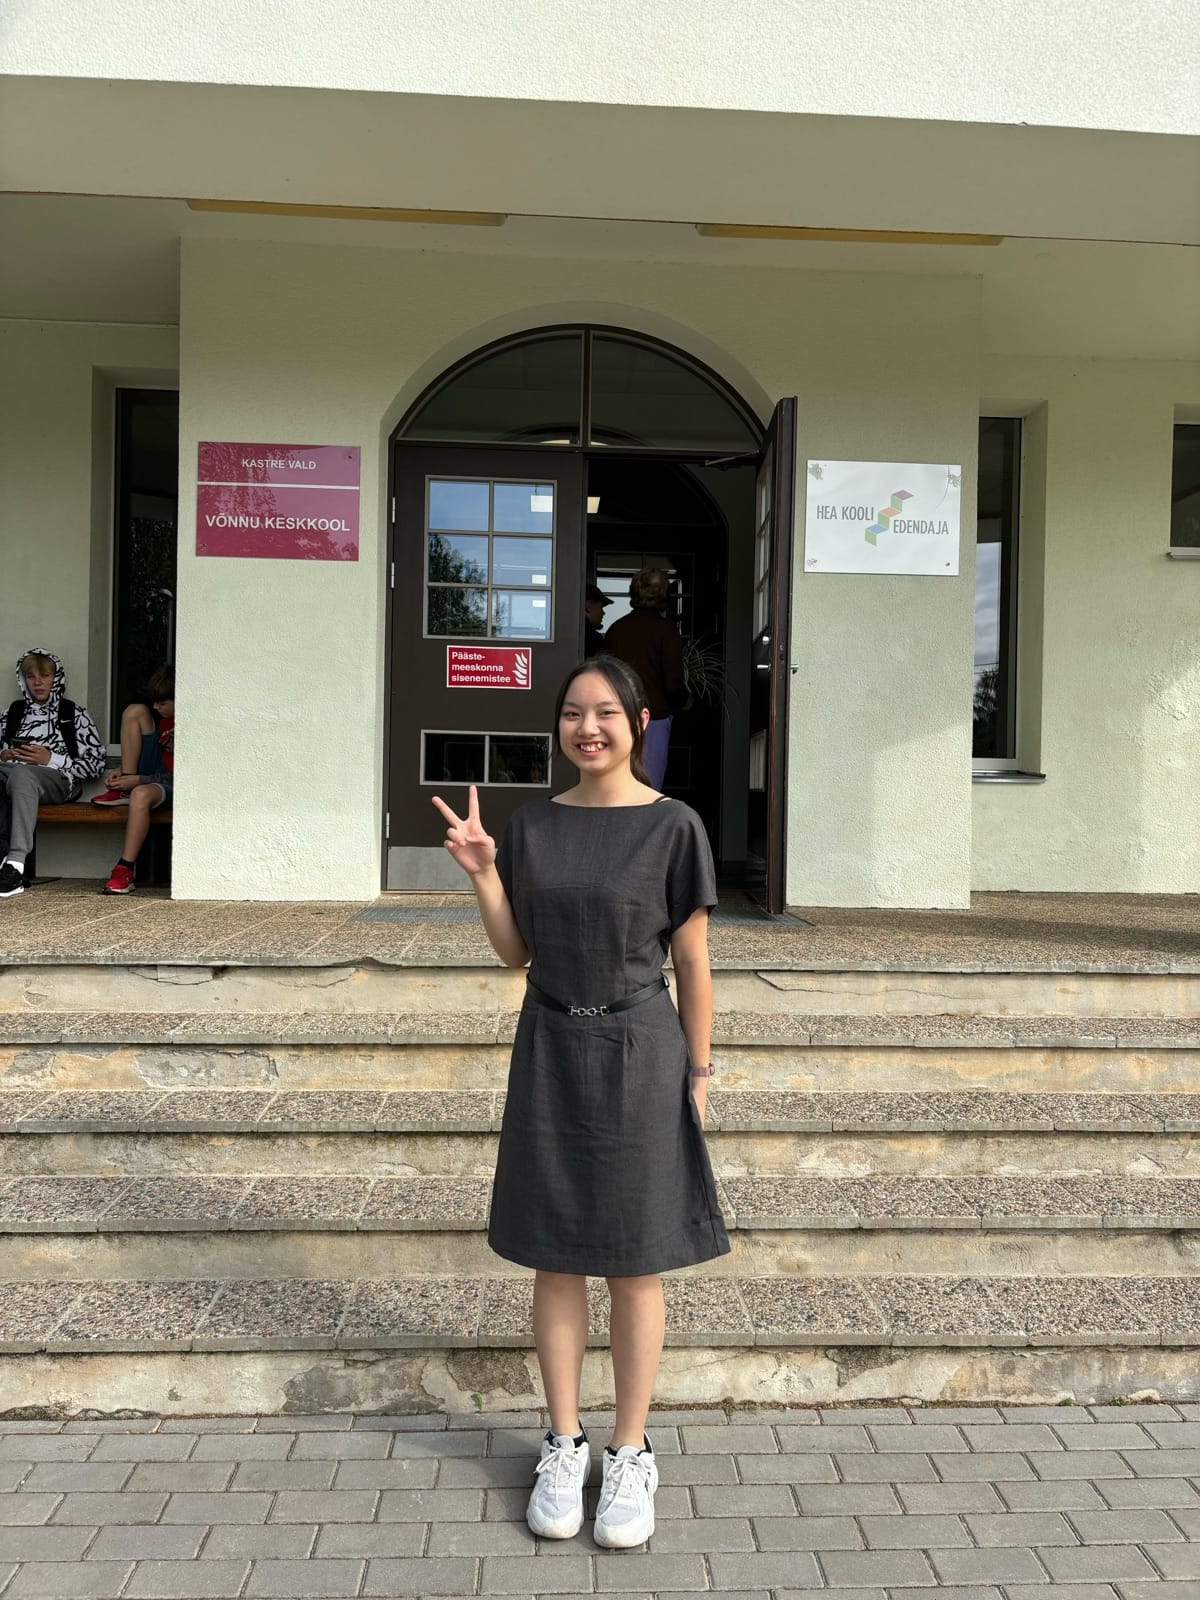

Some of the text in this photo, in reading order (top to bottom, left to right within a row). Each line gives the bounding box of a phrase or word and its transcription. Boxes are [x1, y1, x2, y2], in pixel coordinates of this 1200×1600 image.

[242, 459, 316, 470] KASTRE VALD
[816, 505, 875, 521] HEA KOOLI
[205, 513, 350, 532] VÕNNU KESKKOOL
[893, 519, 949, 535] EDENDAJA
[452, 651, 486, 661] Pääste-
[452, 663, 504, 672] meeskonna
[452, 673, 511, 683] sisenemistee
